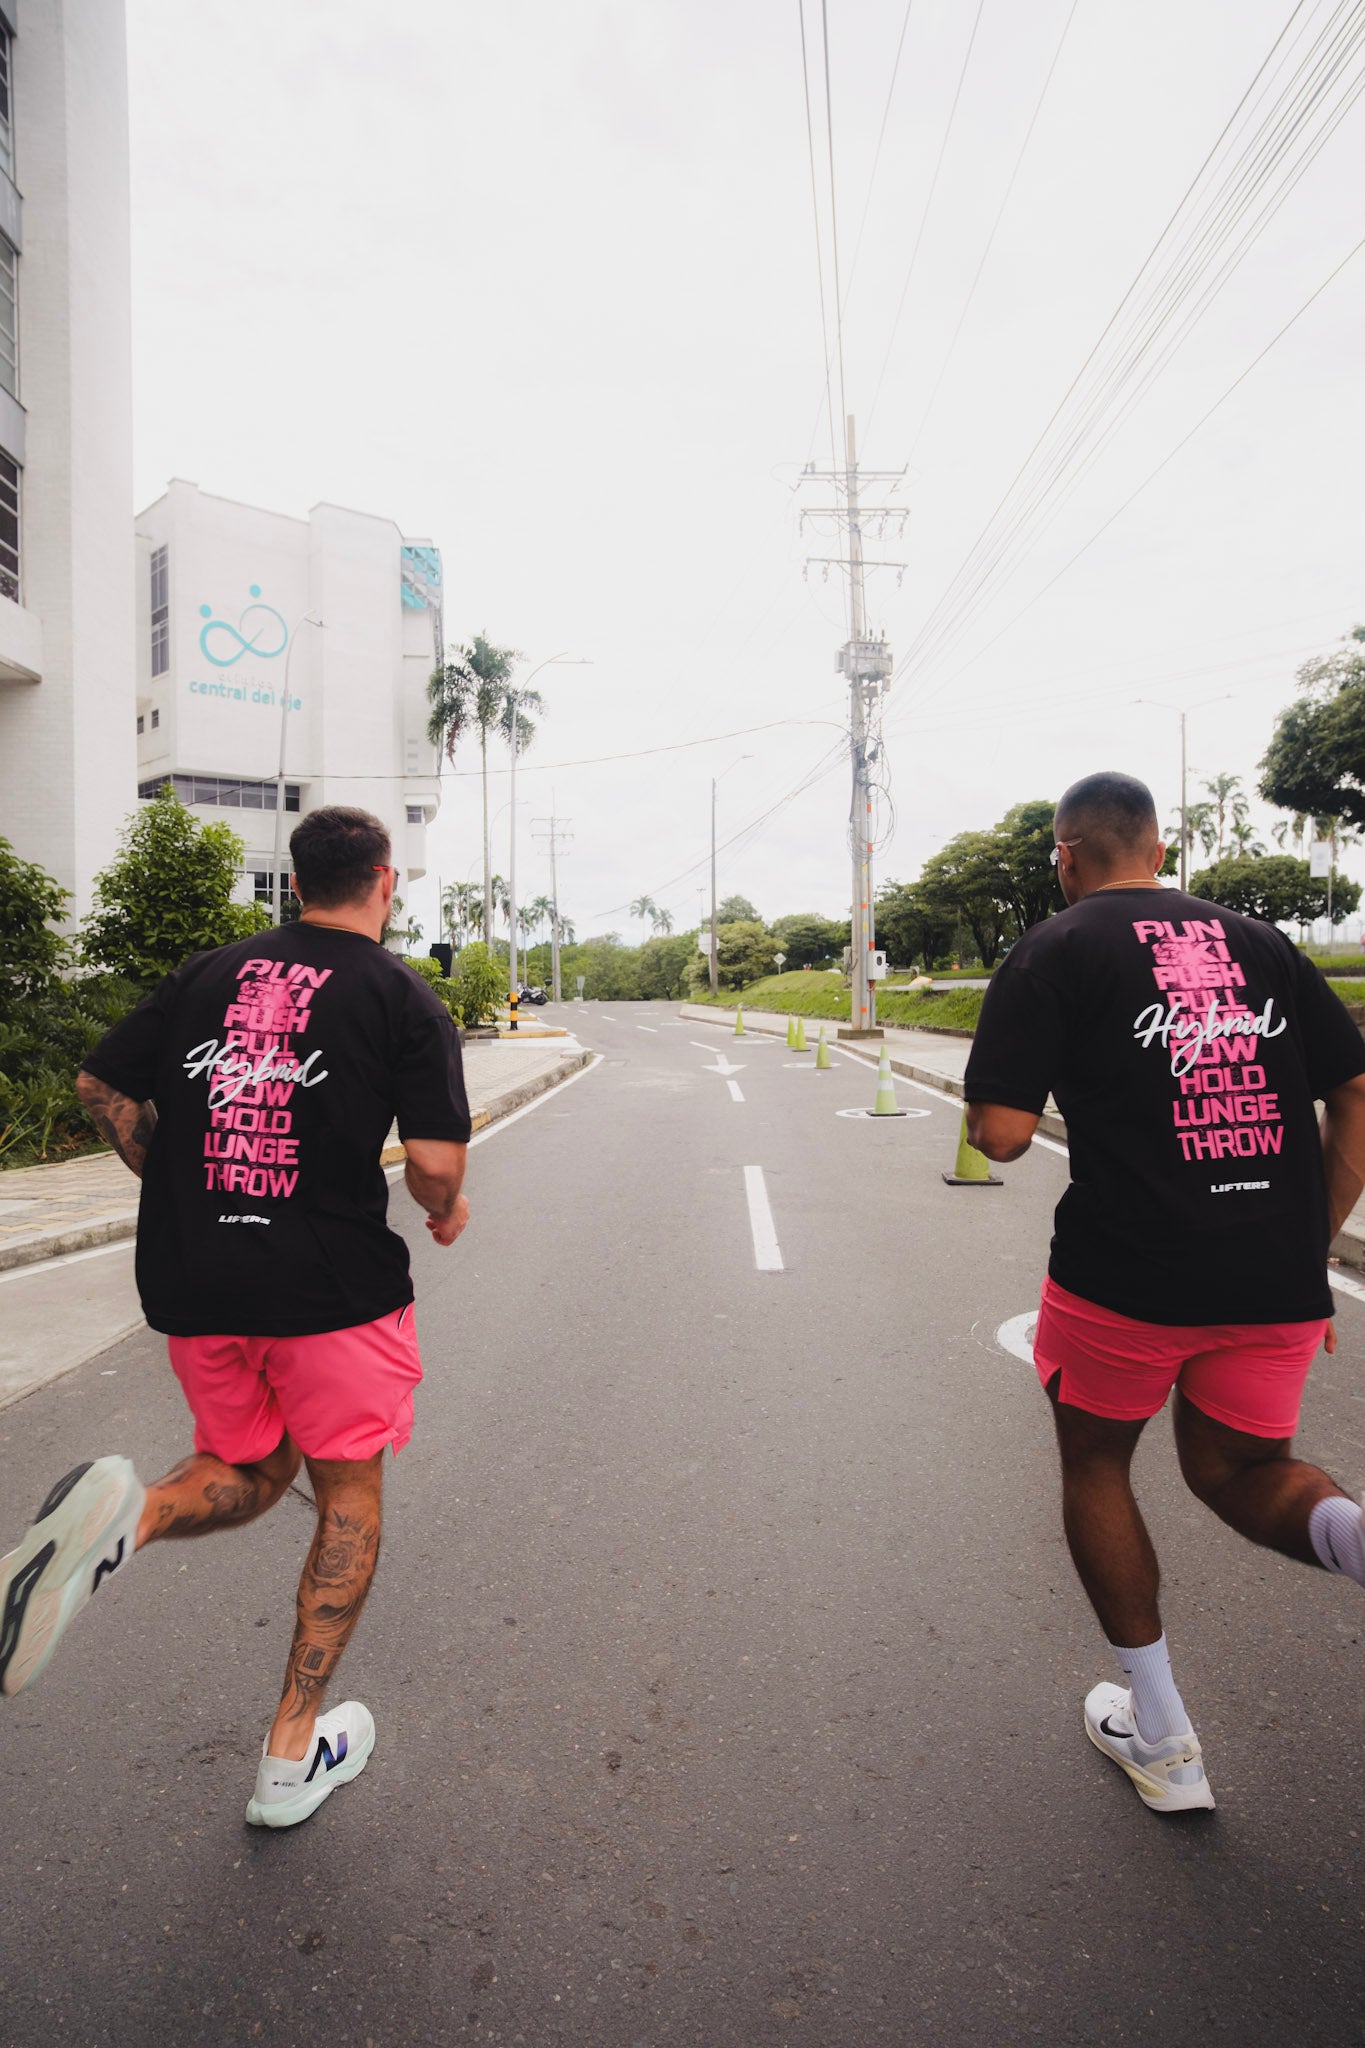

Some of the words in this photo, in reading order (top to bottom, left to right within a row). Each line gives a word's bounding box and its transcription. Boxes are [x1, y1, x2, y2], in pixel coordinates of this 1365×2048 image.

[189, 681, 247, 701] central
[251, 688, 275, 705] del
[1132, 919, 1226, 944] RUN
[1151, 940, 1232, 965] SKI
[235, 958, 333, 989] RUN
[1152, 962, 1247, 991] PUSH
[1166, 988, 1248, 1013] PULL
[223, 1003, 312, 1033] PUSH
[1133, 997, 1287, 1078] Hybrid
[1169, 1034, 1258, 1067] ROW
[182, 1039, 329, 1110] Hybrid
[1179, 1065, 1267, 1095] HOLD
[210, 1074, 296, 1107] ROW
[211, 1105, 292, 1134] HOLD
[1172, 1093, 1281, 1127] LUNGE
[203, 1132, 300, 1165] LUNGE
[1176, 1125, 1285, 1161] THROW
[203, 1163, 299, 1198] THROW
[1210, 1181, 1270, 1193] LIFTERS
[218, 1214, 271, 1225] LIFERS
[304, 1730, 348, 1782] N
